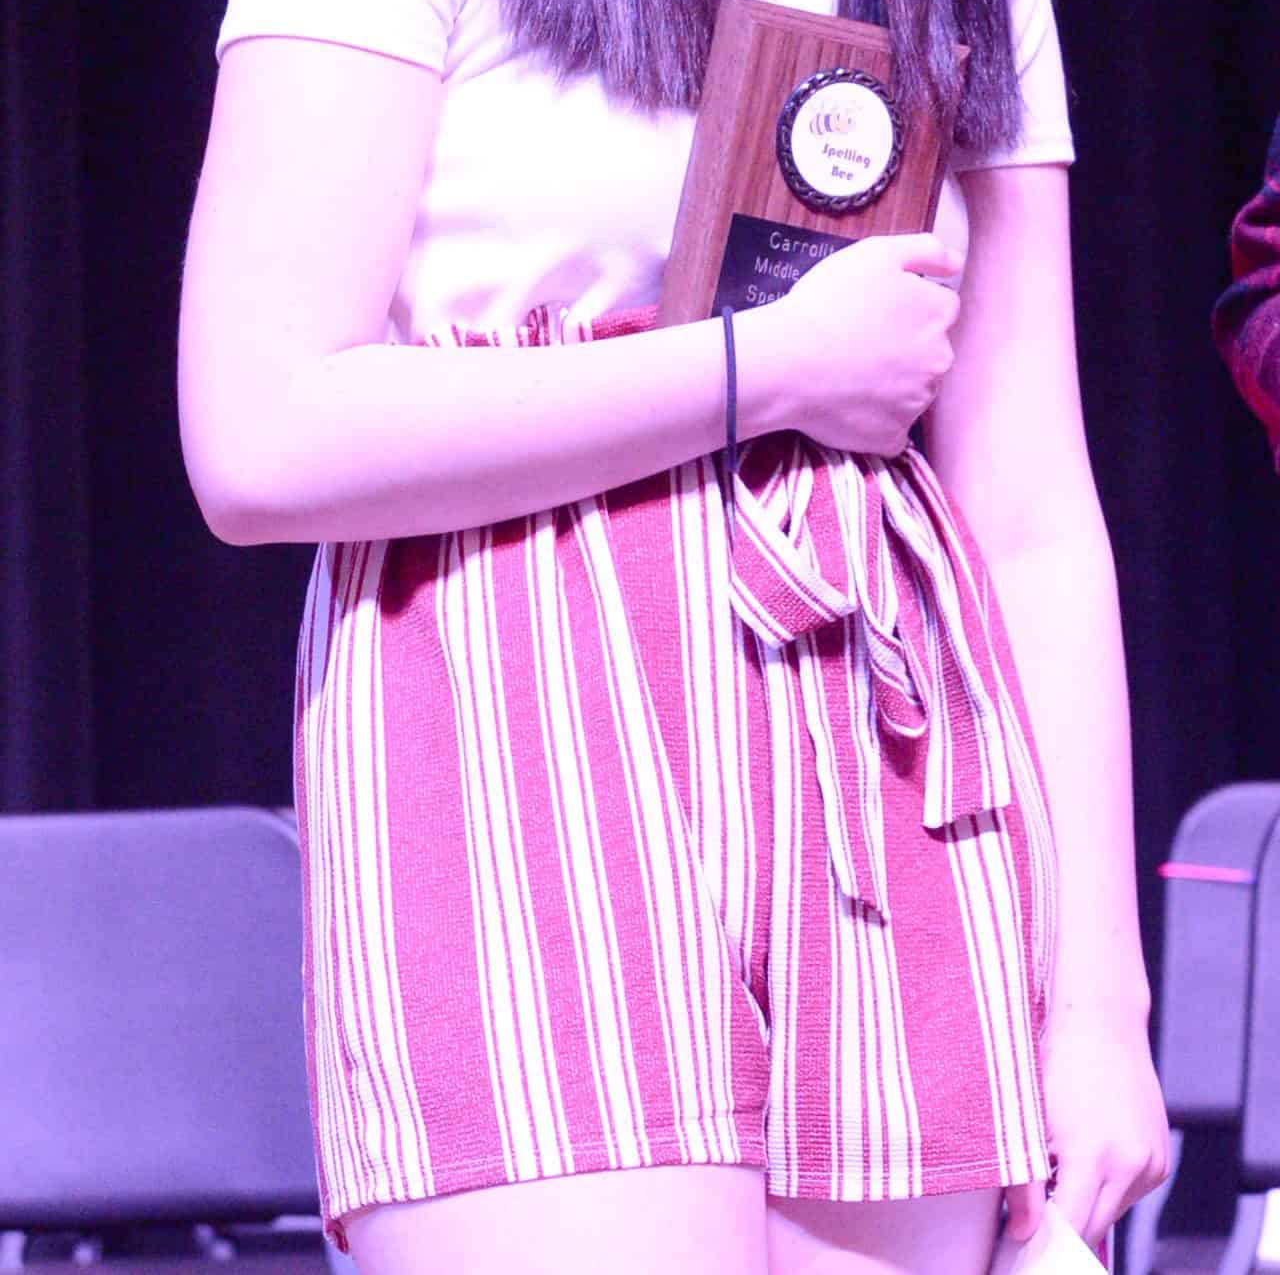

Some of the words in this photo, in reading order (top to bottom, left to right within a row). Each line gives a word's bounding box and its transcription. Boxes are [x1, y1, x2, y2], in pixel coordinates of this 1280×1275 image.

[822, 143, 871, 169] Spelling
[831, 164, 854, 181] Bee
[754, 256, 800, 281] Middle
